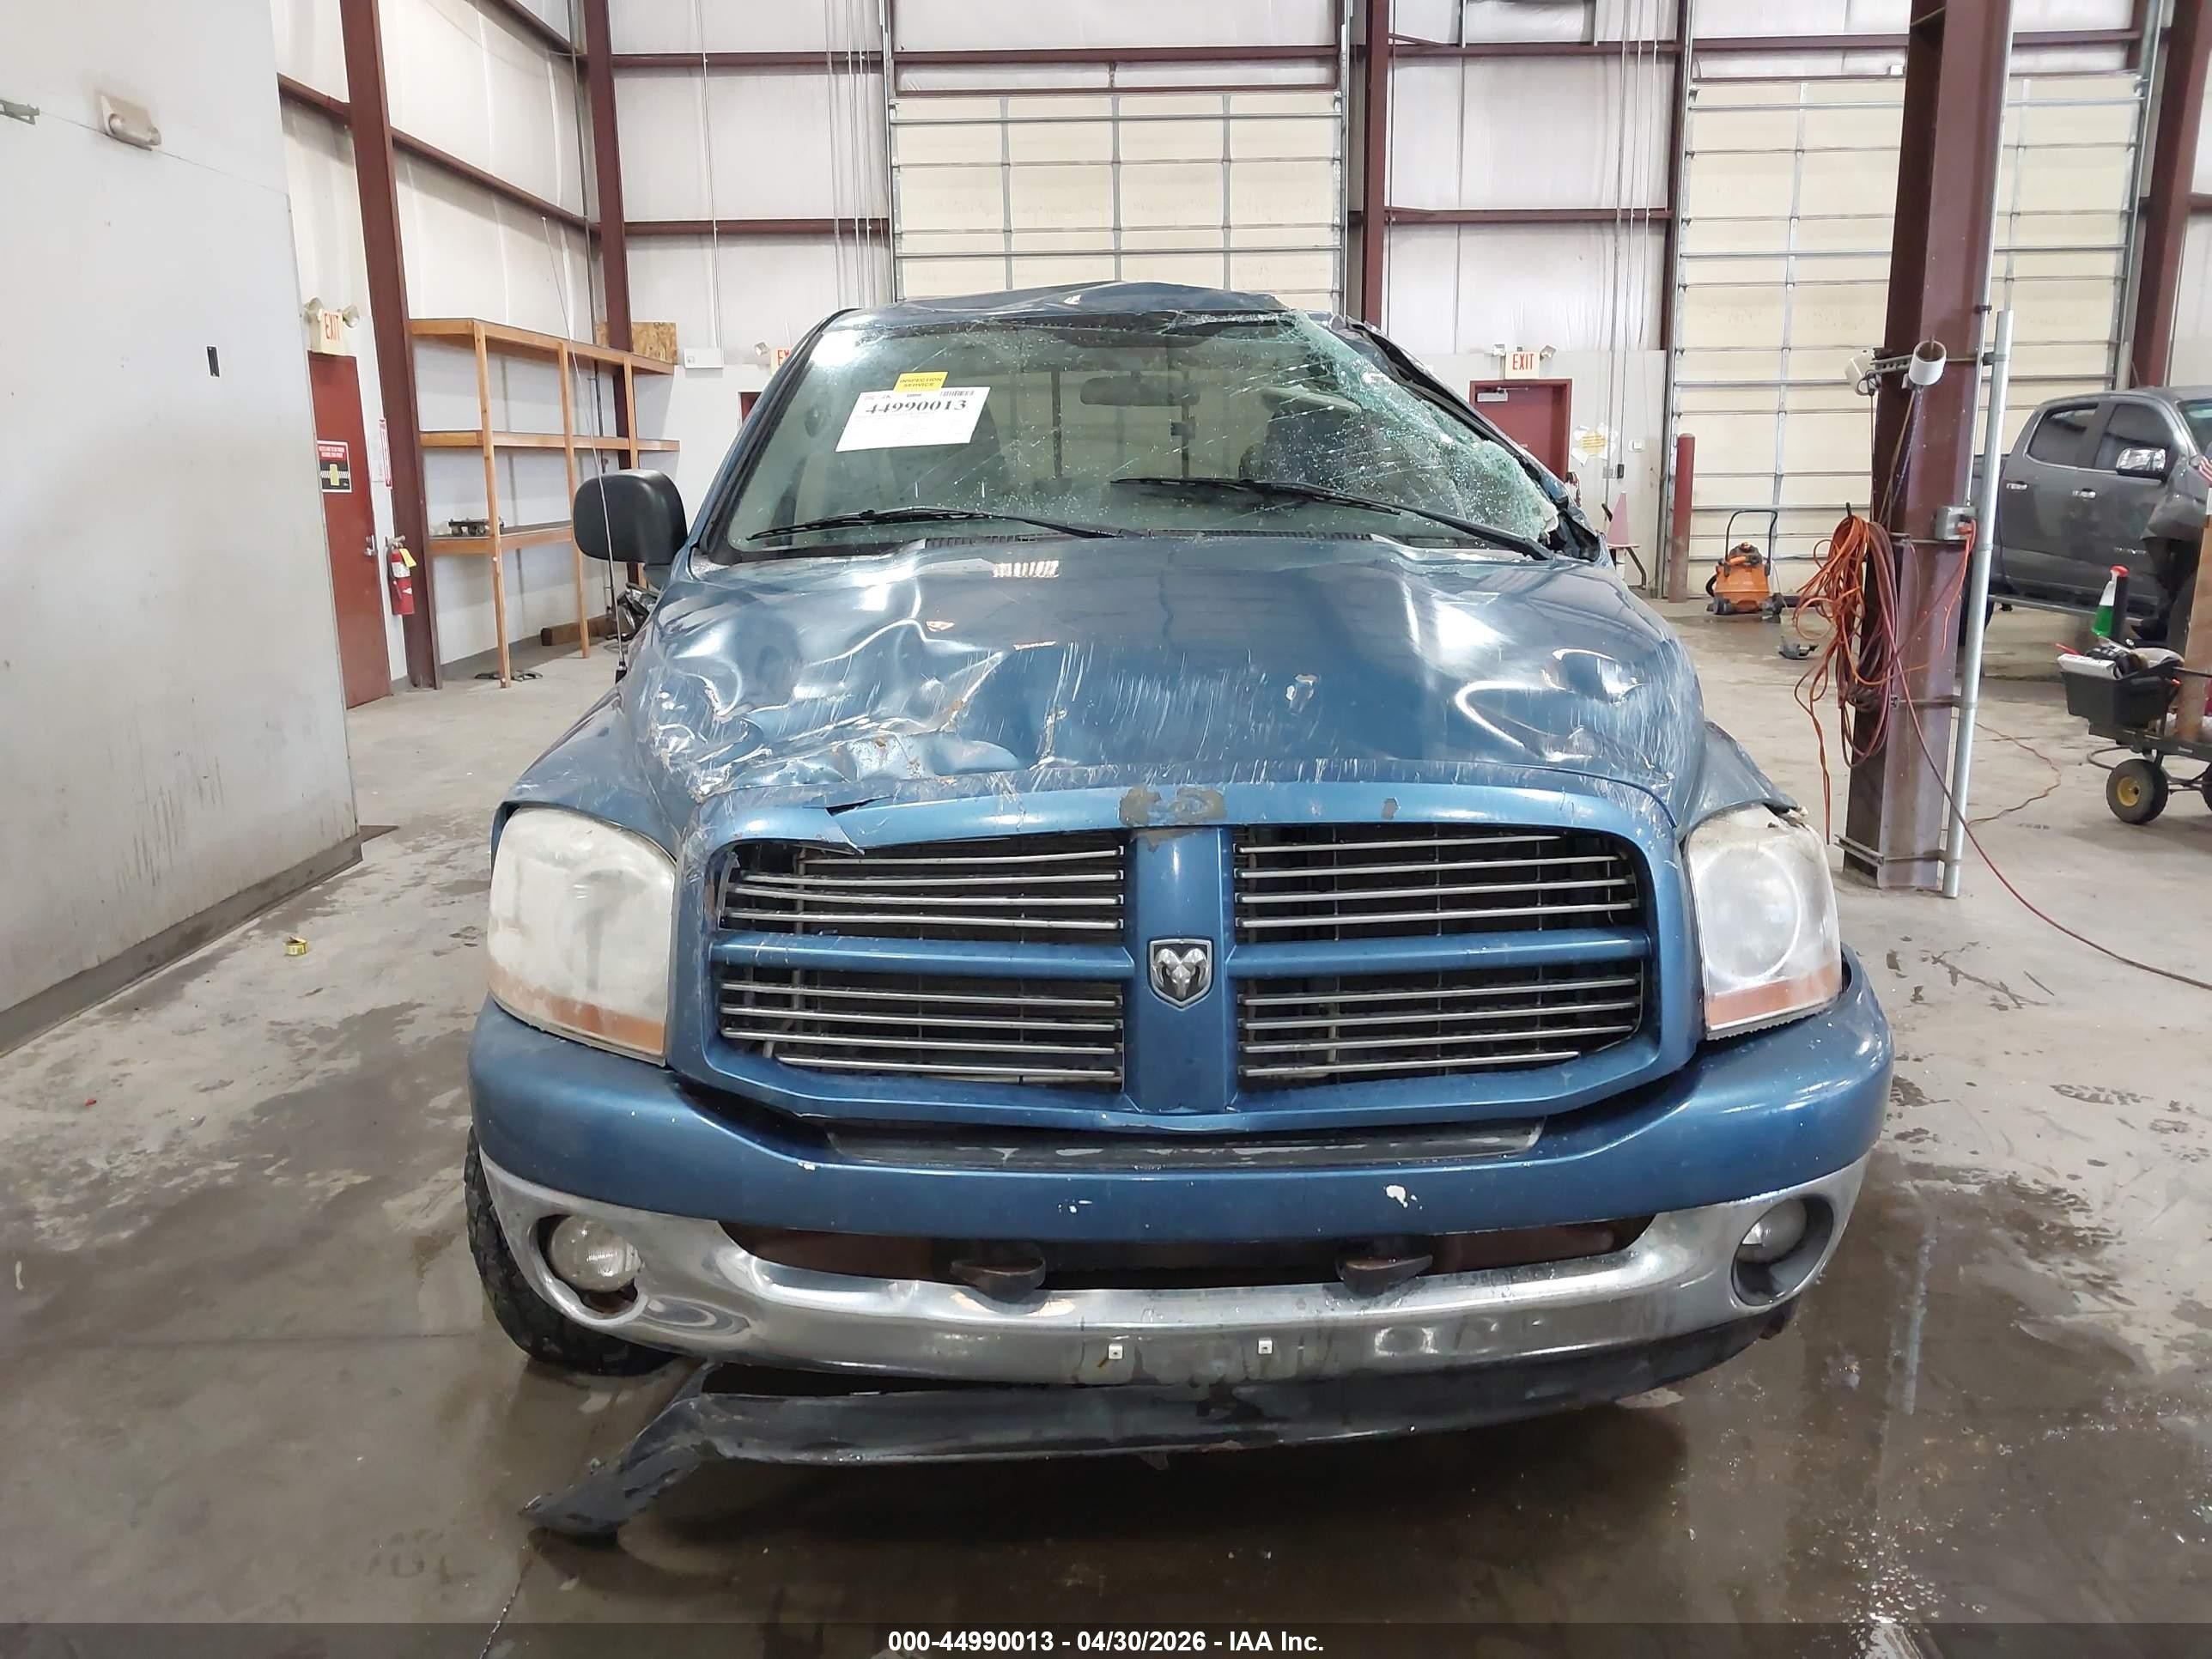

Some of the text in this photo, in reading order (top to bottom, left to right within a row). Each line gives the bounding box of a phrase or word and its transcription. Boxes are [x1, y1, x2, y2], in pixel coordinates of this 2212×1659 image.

[325, 313, 340, 341] EXIT
[1512, 353, 1534, 370] EXIT
[866, 400, 967, 414] 44990013
